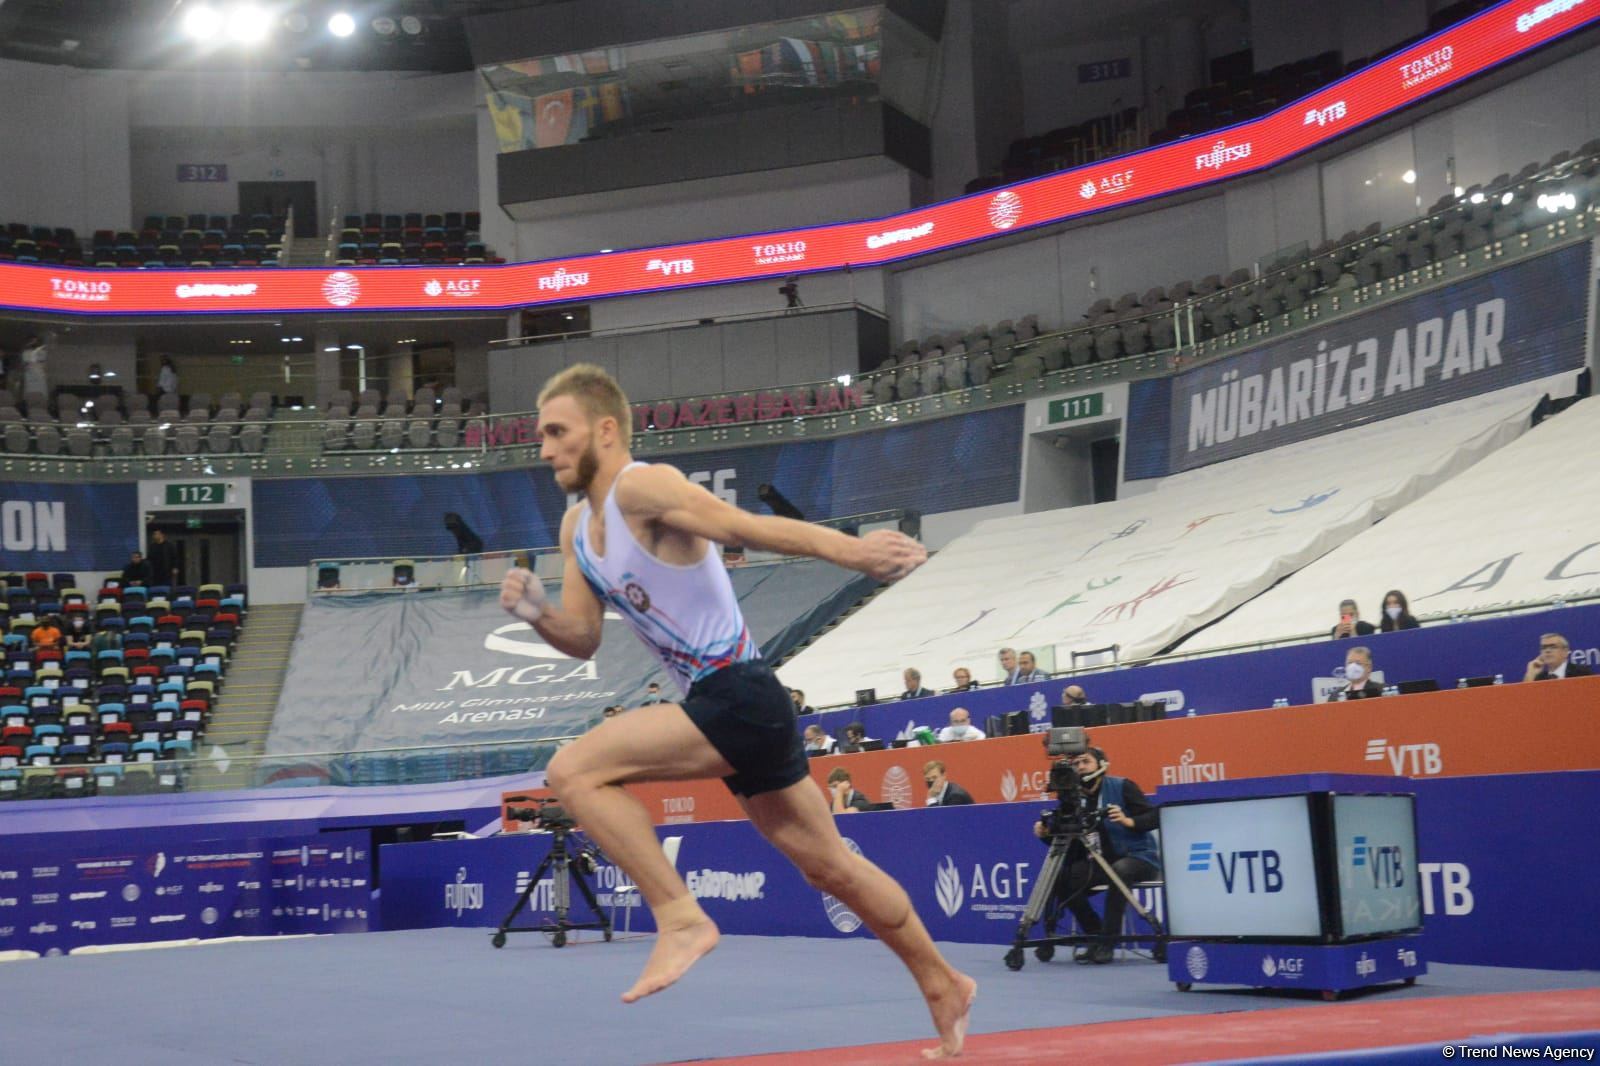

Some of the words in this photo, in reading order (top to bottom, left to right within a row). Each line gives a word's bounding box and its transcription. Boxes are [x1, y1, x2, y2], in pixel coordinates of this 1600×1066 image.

[1316, 101, 1347, 126] VTB
[1195, 141, 1252, 169] FUJITSU
[189, 166, 218, 181] 312
[752, 241, 807, 257] TOKIO
[538, 268, 590, 291] FUJITSU
[662, 259, 695, 276] VTB
[50, 277, 112, 293] TOKIO
[446, 280, 482, 292] AGF
[1383, 297, 1506, 397] APAR
[1061, 397, 1091, 418] 111
[178, 486, 213, 502] 112
[0, 500, 67, 552] ON
[435, 660, 601, 691] MGA
[460, 691, 617, 709] Gimnastika
[1387, 743, 1443, 777] VTB
[1215, 849, 1284, 894] VTB
[1368, 846, 1404, 889] VTB
[970, 862, 1031, 899] AGF
[1418, 862, 1475, 916] TB
[1277, 958, 1304, 972] AGF
